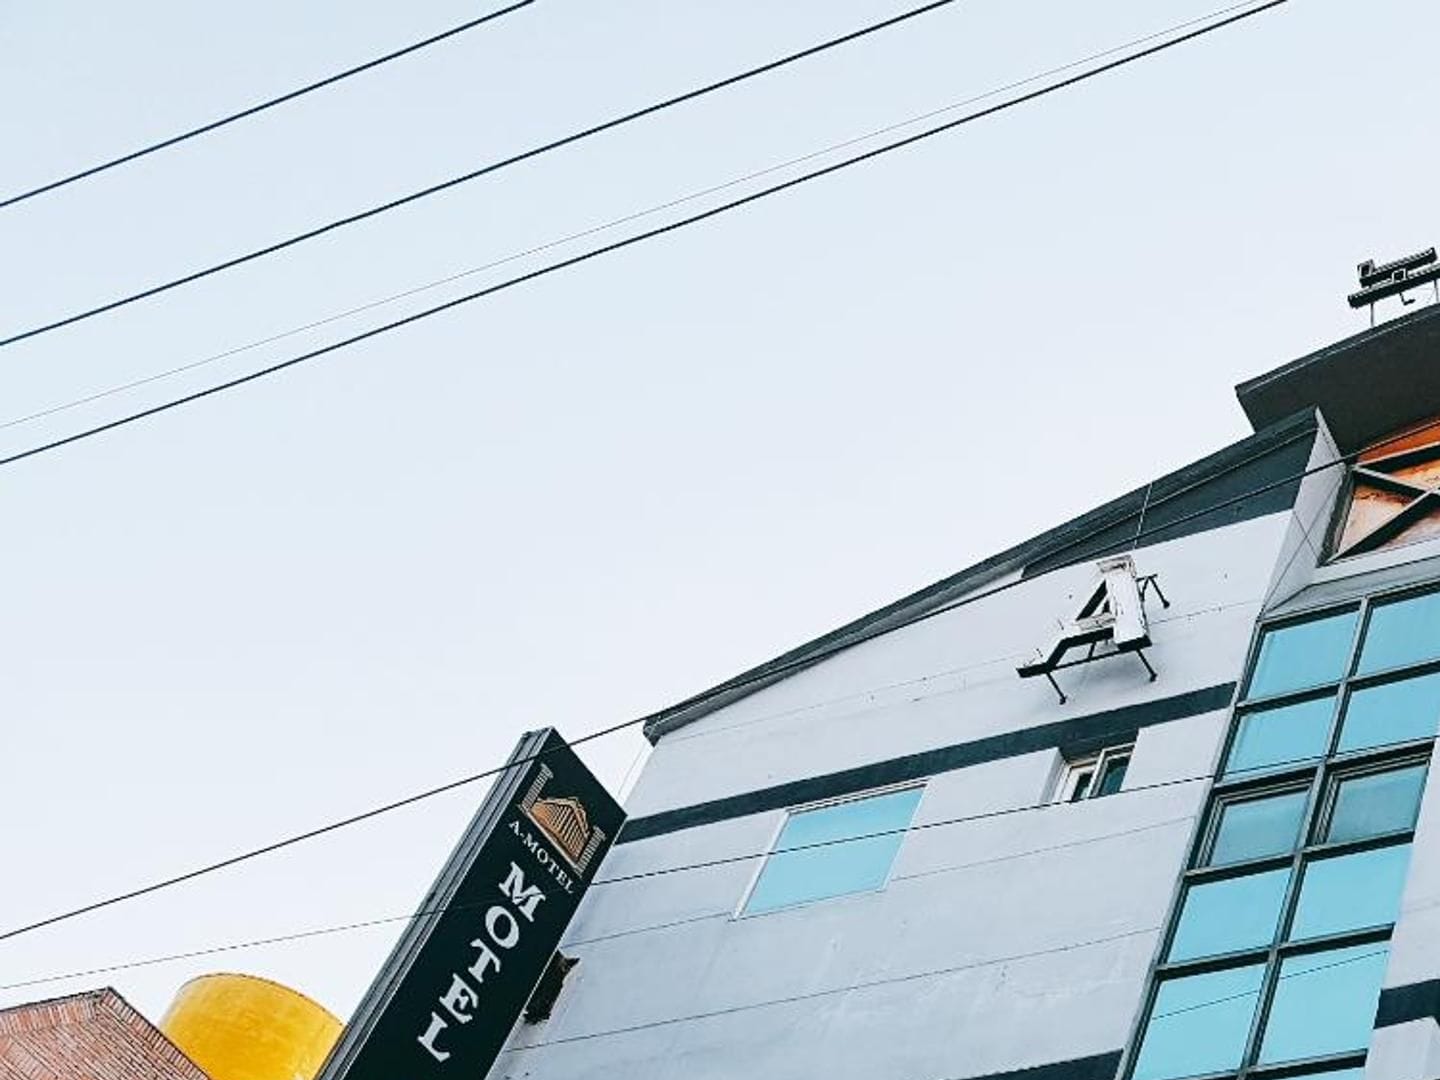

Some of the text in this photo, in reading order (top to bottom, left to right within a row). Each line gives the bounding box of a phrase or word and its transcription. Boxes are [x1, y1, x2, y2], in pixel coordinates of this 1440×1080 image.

[1014, 553, 1152, 679] A
[508, 820, 574, 895] A-MOTEL
[418, 861, 546, 1063] MOTEL
